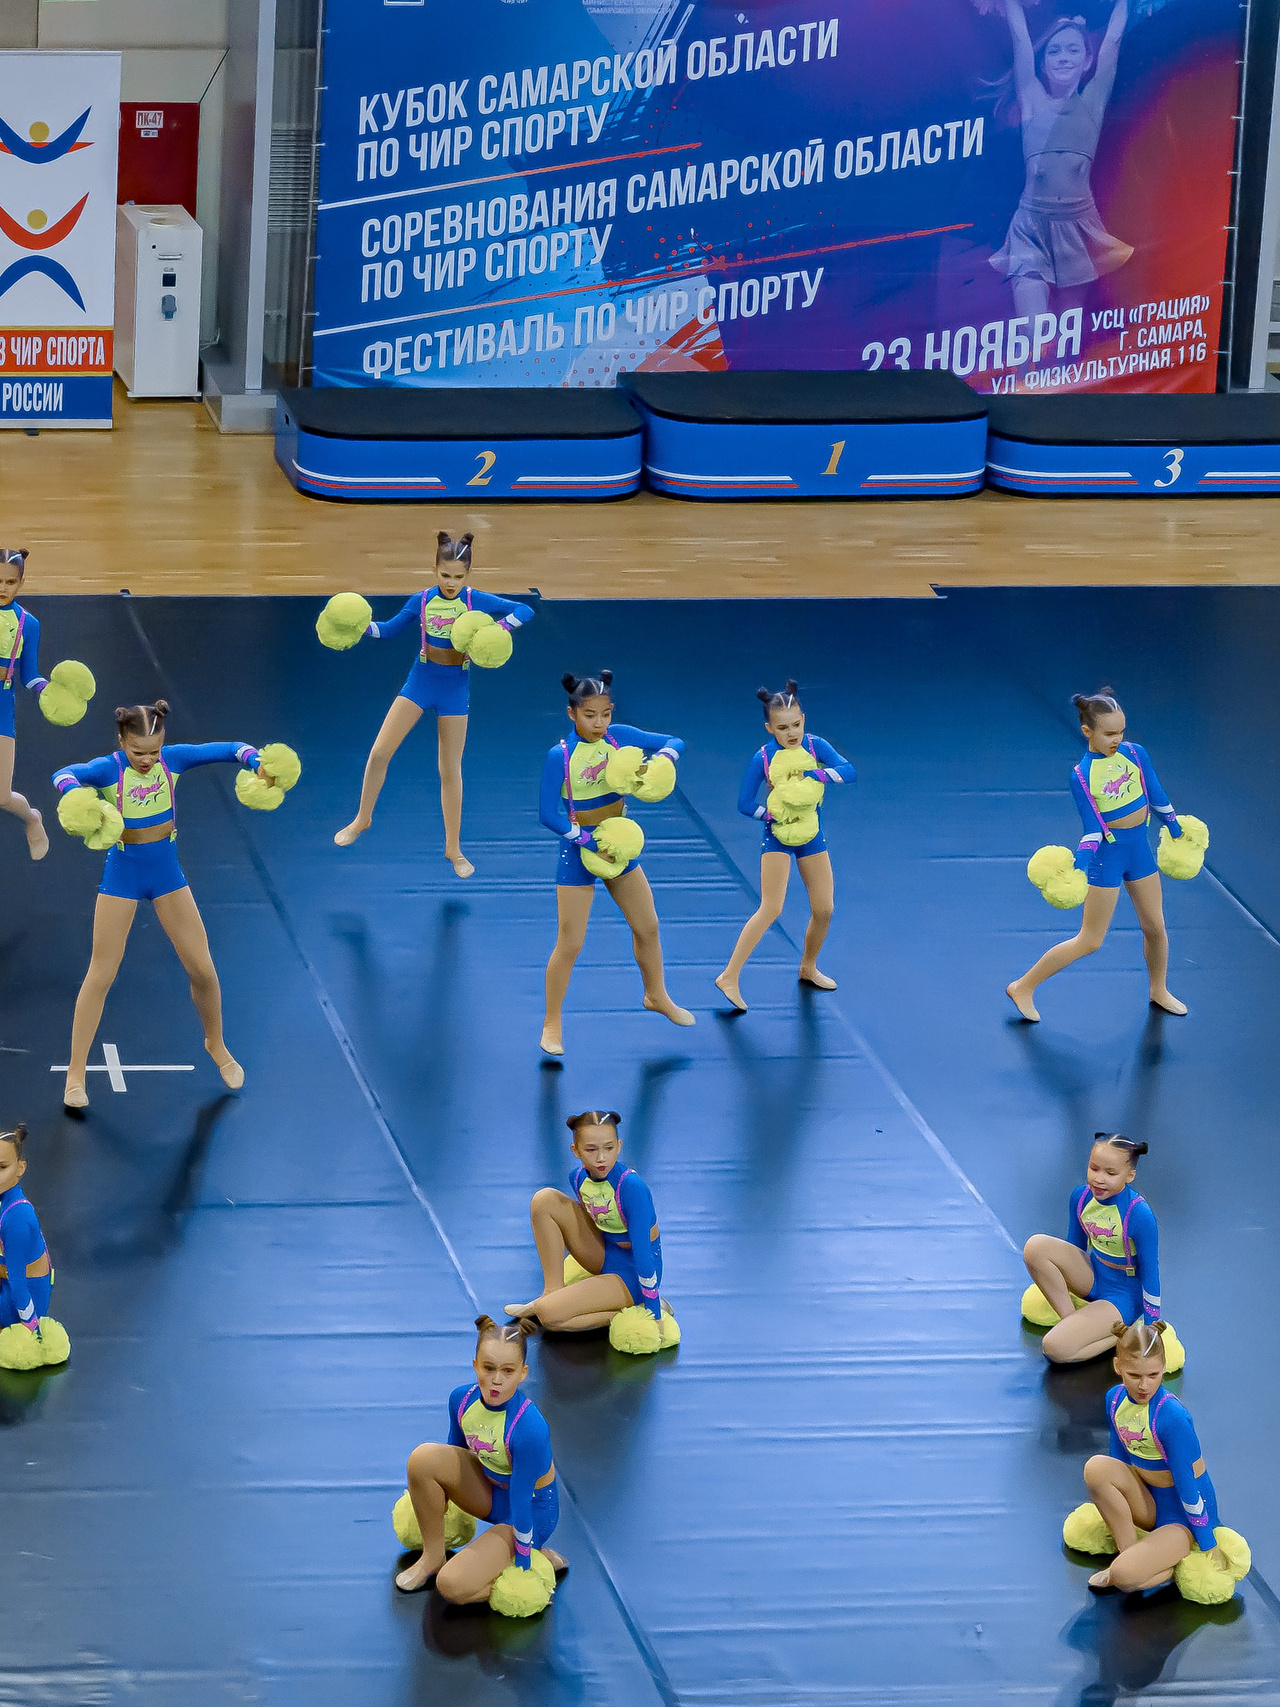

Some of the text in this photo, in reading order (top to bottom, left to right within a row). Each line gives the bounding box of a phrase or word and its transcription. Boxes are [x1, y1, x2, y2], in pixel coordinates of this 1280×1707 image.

[358, 18, 839, 136] КУБОК САМАРСКОЙ ОБЛАСТИ
[356, 101, 611, 182] ПО ЧИР СПОРТУ
[361, 117, 984, 258] СОРЕВНОВАНИЯ САМАРСКОЙ ОБЛАСТИ
[361, 223, 613, 303] ПО ЧИР СПОРТУ
[362, 267, 825, 380] ФЕСТИВАЛЬ ПО ЧИР СПОРТУ
[1091, 294, 1210, 332] УСЦ «ГРАЦИЯ»
[1119, 318, 1208, 351] Г. САМАРА,
[10, 336, 43, 366] ЧИР
[46, 336, 106, 366] СПОРТА
[861, 307, 1083, 376] 23 НОЯБРЯ
[991, 341, 1208, 395] УЛ. ФИЗКУЛЬТУРНАЯ, 116
[2, 382, 64, 412] РОССИИ
[466, 450, 496, 486] 2
[821, 440, 846, 475] 1
[1153, 448, 1185, 488] 3
